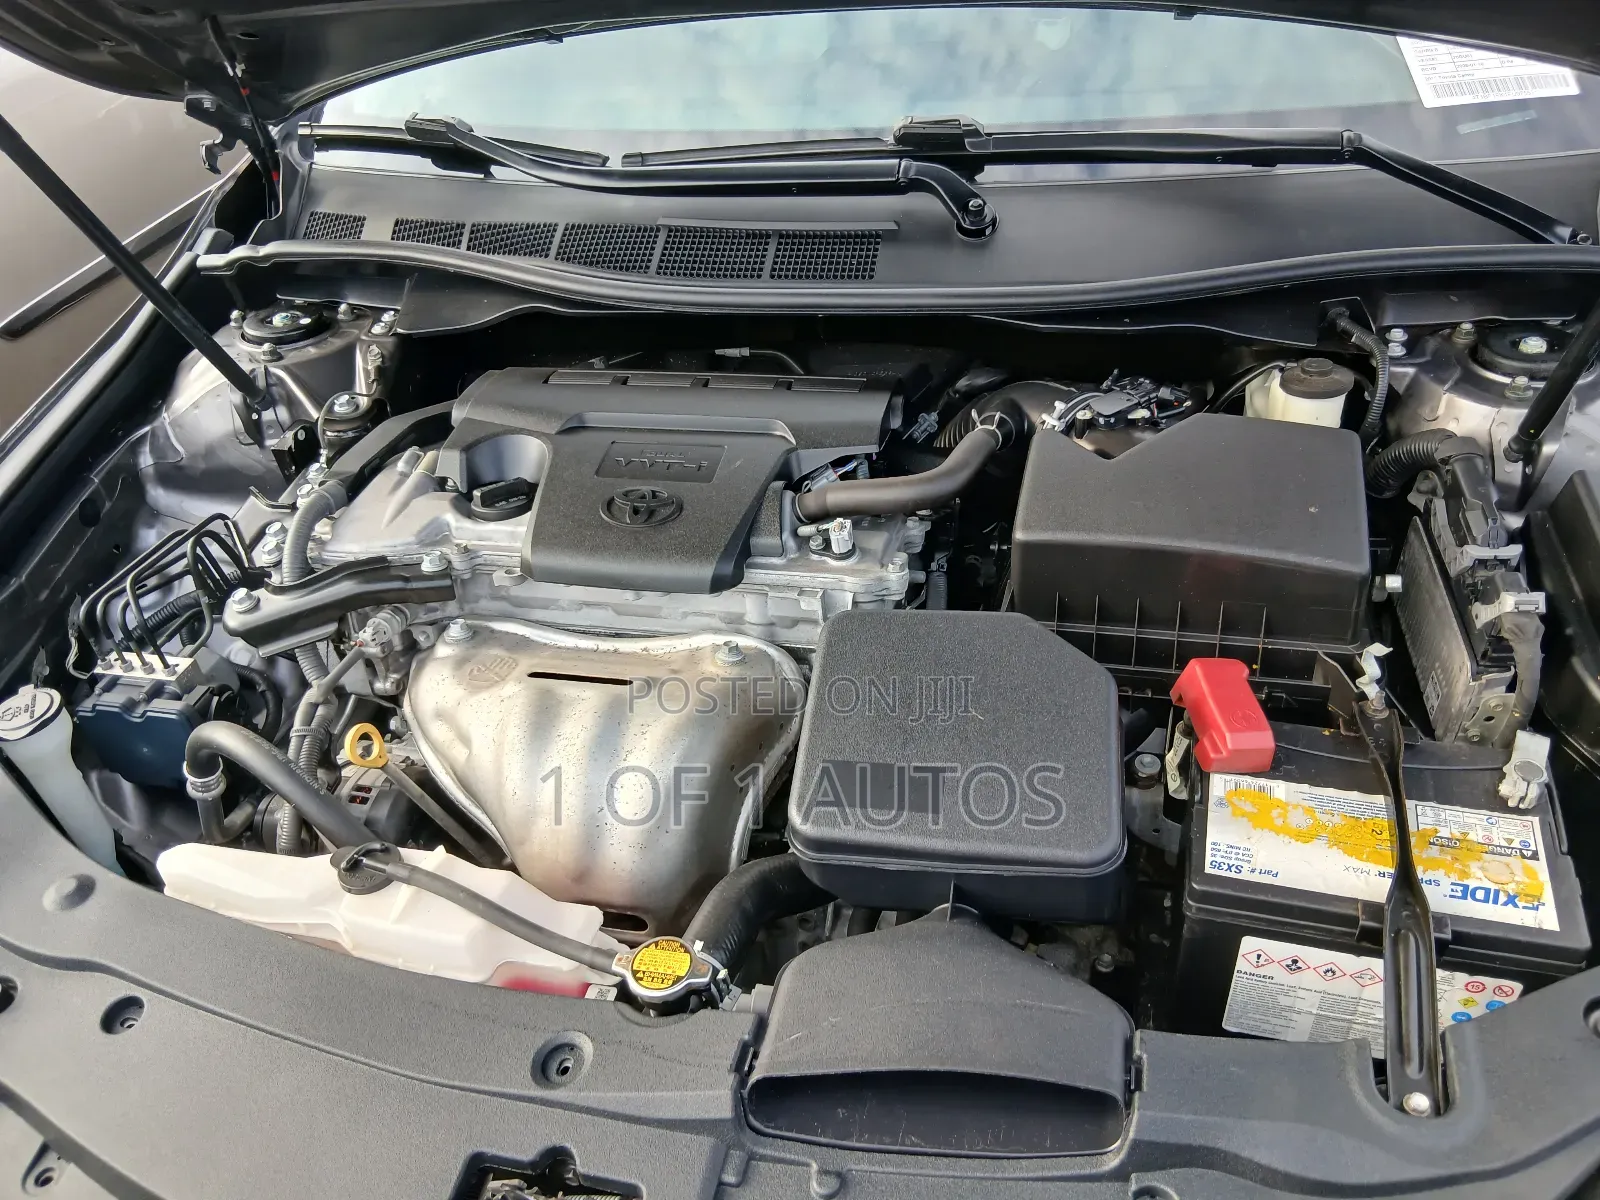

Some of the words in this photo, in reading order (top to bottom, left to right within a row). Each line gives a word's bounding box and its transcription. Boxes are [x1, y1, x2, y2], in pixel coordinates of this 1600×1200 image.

[1209, 860, 1244, 874] SX35
[1258, 868, 1279, 878] Part
[1342, 864, 1371, 876] MAX
[1236, 969, 1274, 981] DANGER
